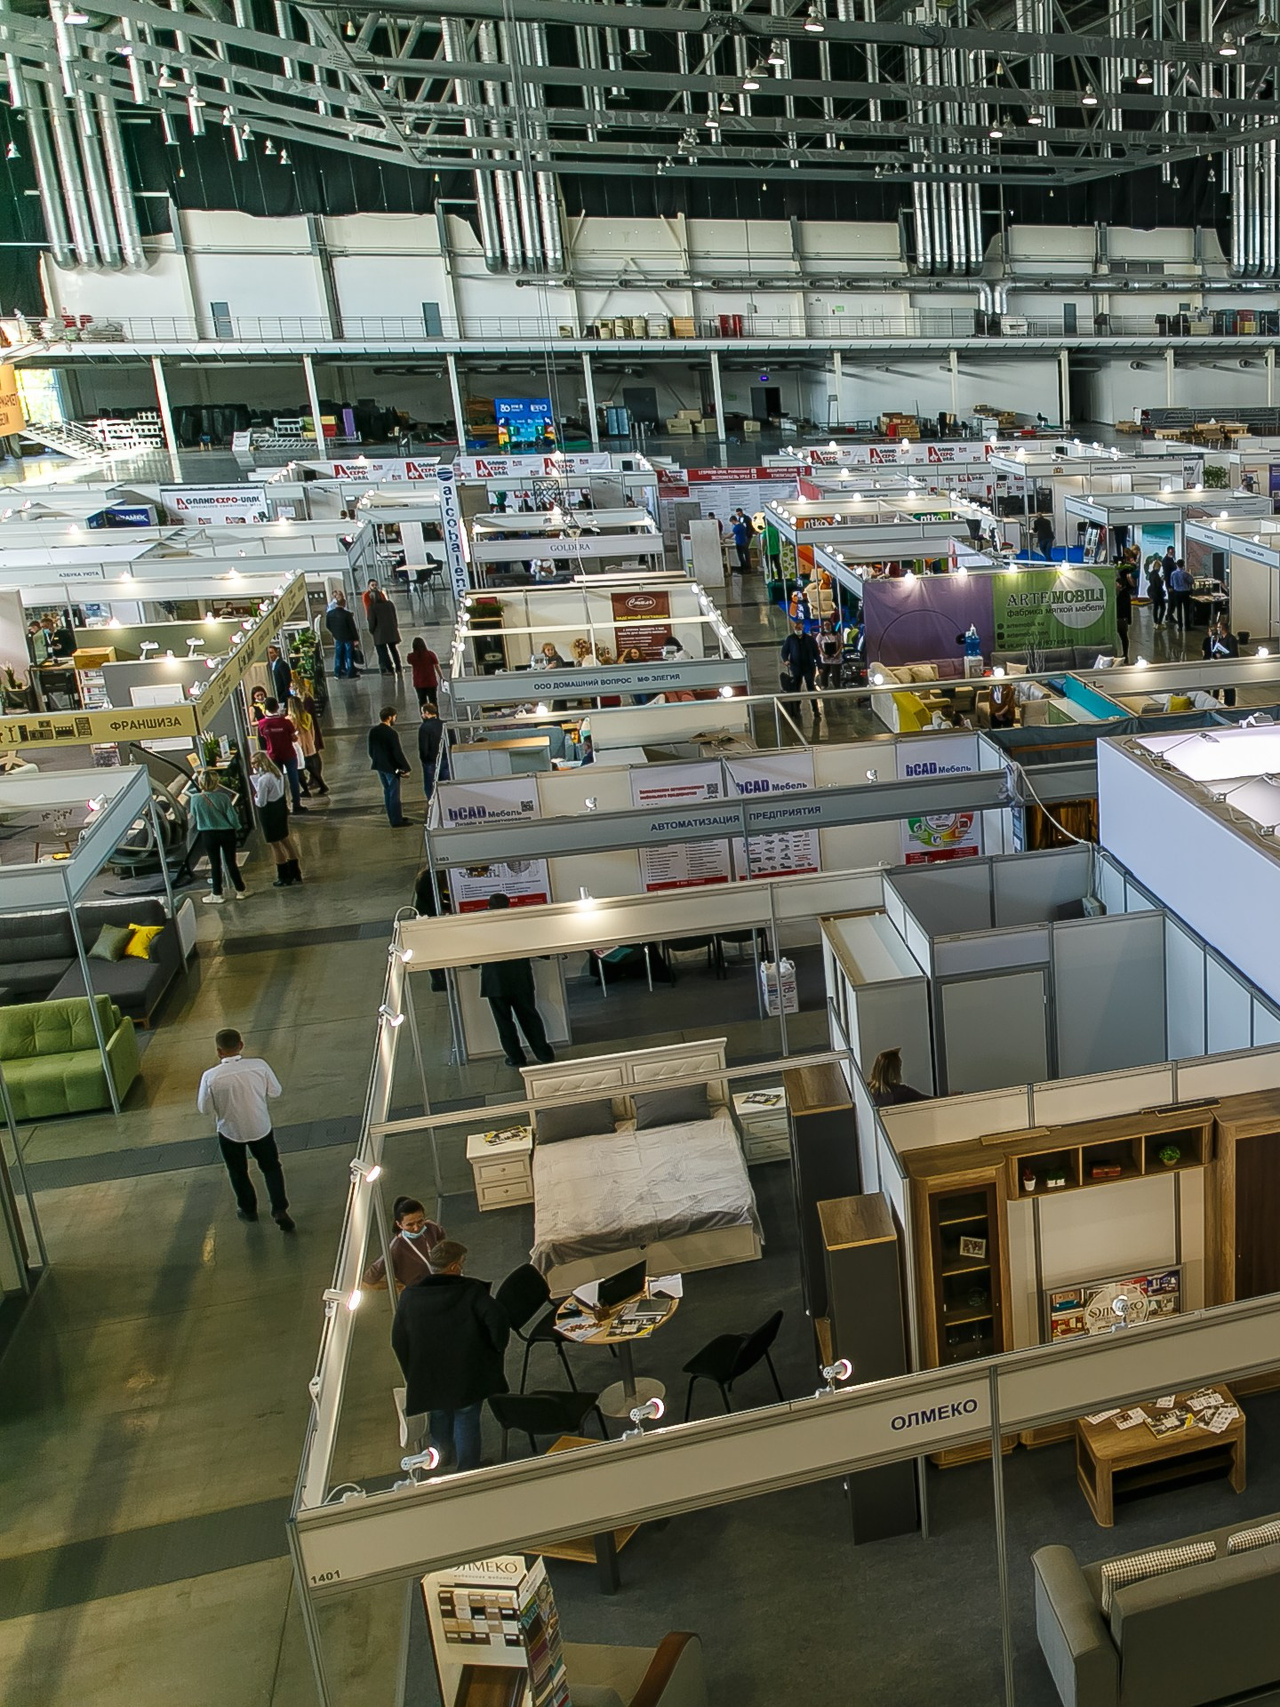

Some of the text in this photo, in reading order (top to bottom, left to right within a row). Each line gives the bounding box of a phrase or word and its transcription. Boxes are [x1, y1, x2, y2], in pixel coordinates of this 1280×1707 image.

[550, 542, 591, 551] GOLDERA
[1007, 602, 1105, 618] фабрика мягкой мебели
[552, 679, 599, 690] ДОМАШНИЙ
[601, 677, 632, 686] ВОПРОС
[637, 675, 650, 683] МФ
[651, 673, 680, 682] ЭЛЕГИЯ
[109, 716, 182, 732] ФРАНШИЗА
[906, 762, 972, 776] bCAD Мебель
[771, 782, 807, 792] Мебель
[448, 805, 522, 821] bCAD Мебель
[651, 806, 821, 832] АВТОМАТИЗАЦИЯ ПРЕДПРИЯТИЯ
[890, 1398, 979, 1433] ОЛМЕКО
[311, 1569, 341, 1585] 1401
